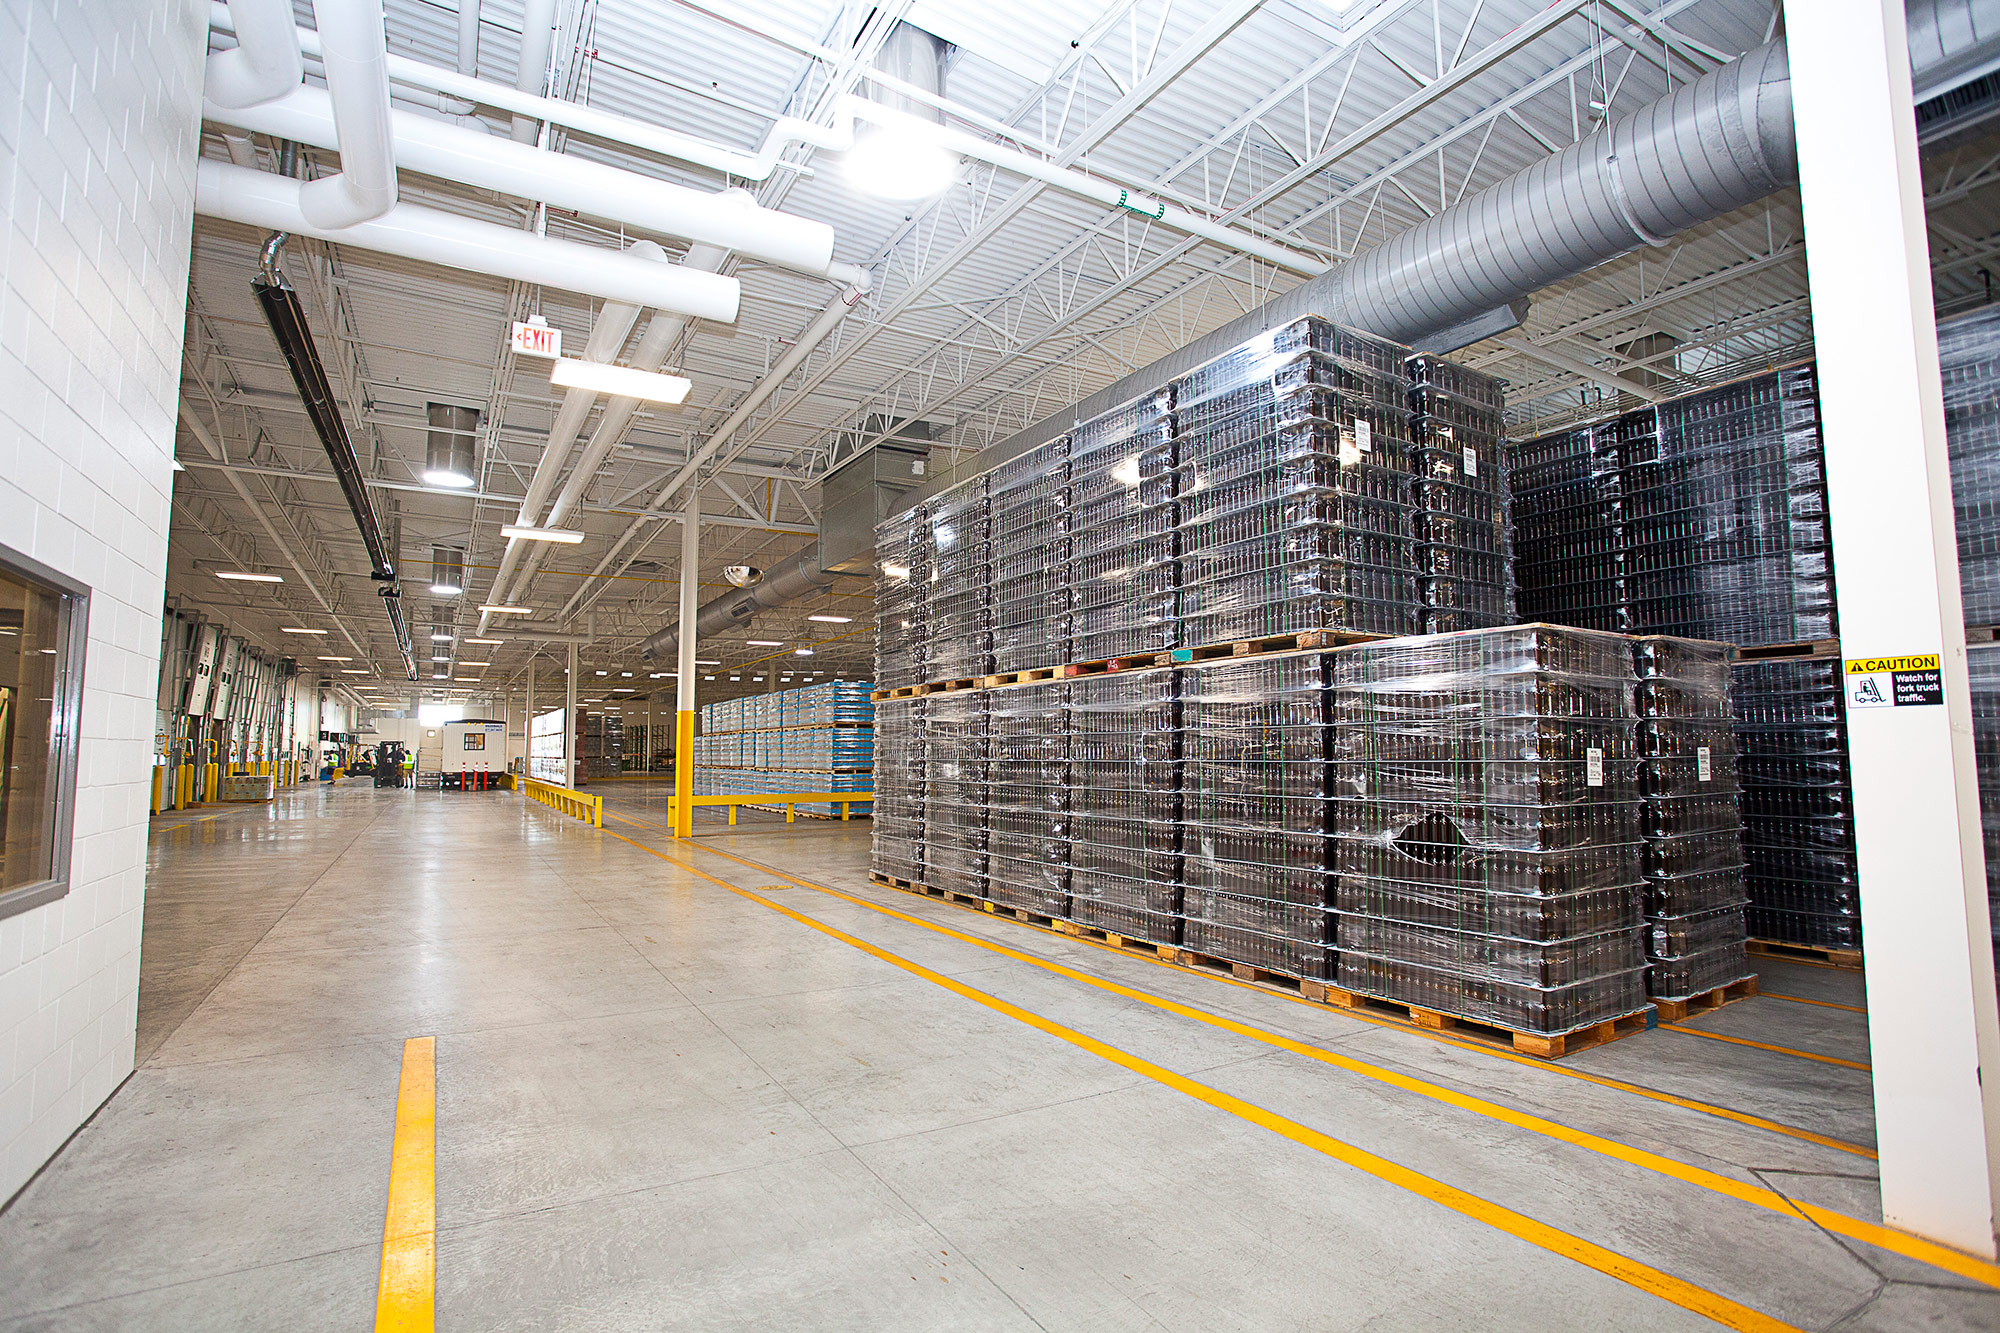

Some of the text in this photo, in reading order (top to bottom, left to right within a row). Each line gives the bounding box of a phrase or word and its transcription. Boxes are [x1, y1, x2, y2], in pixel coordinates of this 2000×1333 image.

[522, 327, 554, 352] EXIT
[1865, 657, 1935, 671] CAUTION
[1896, 673, 1938, 682] Watch for
[1897, 683, 1939, 692] fork truck
[1898, 694, 1926, 702] traffic.
